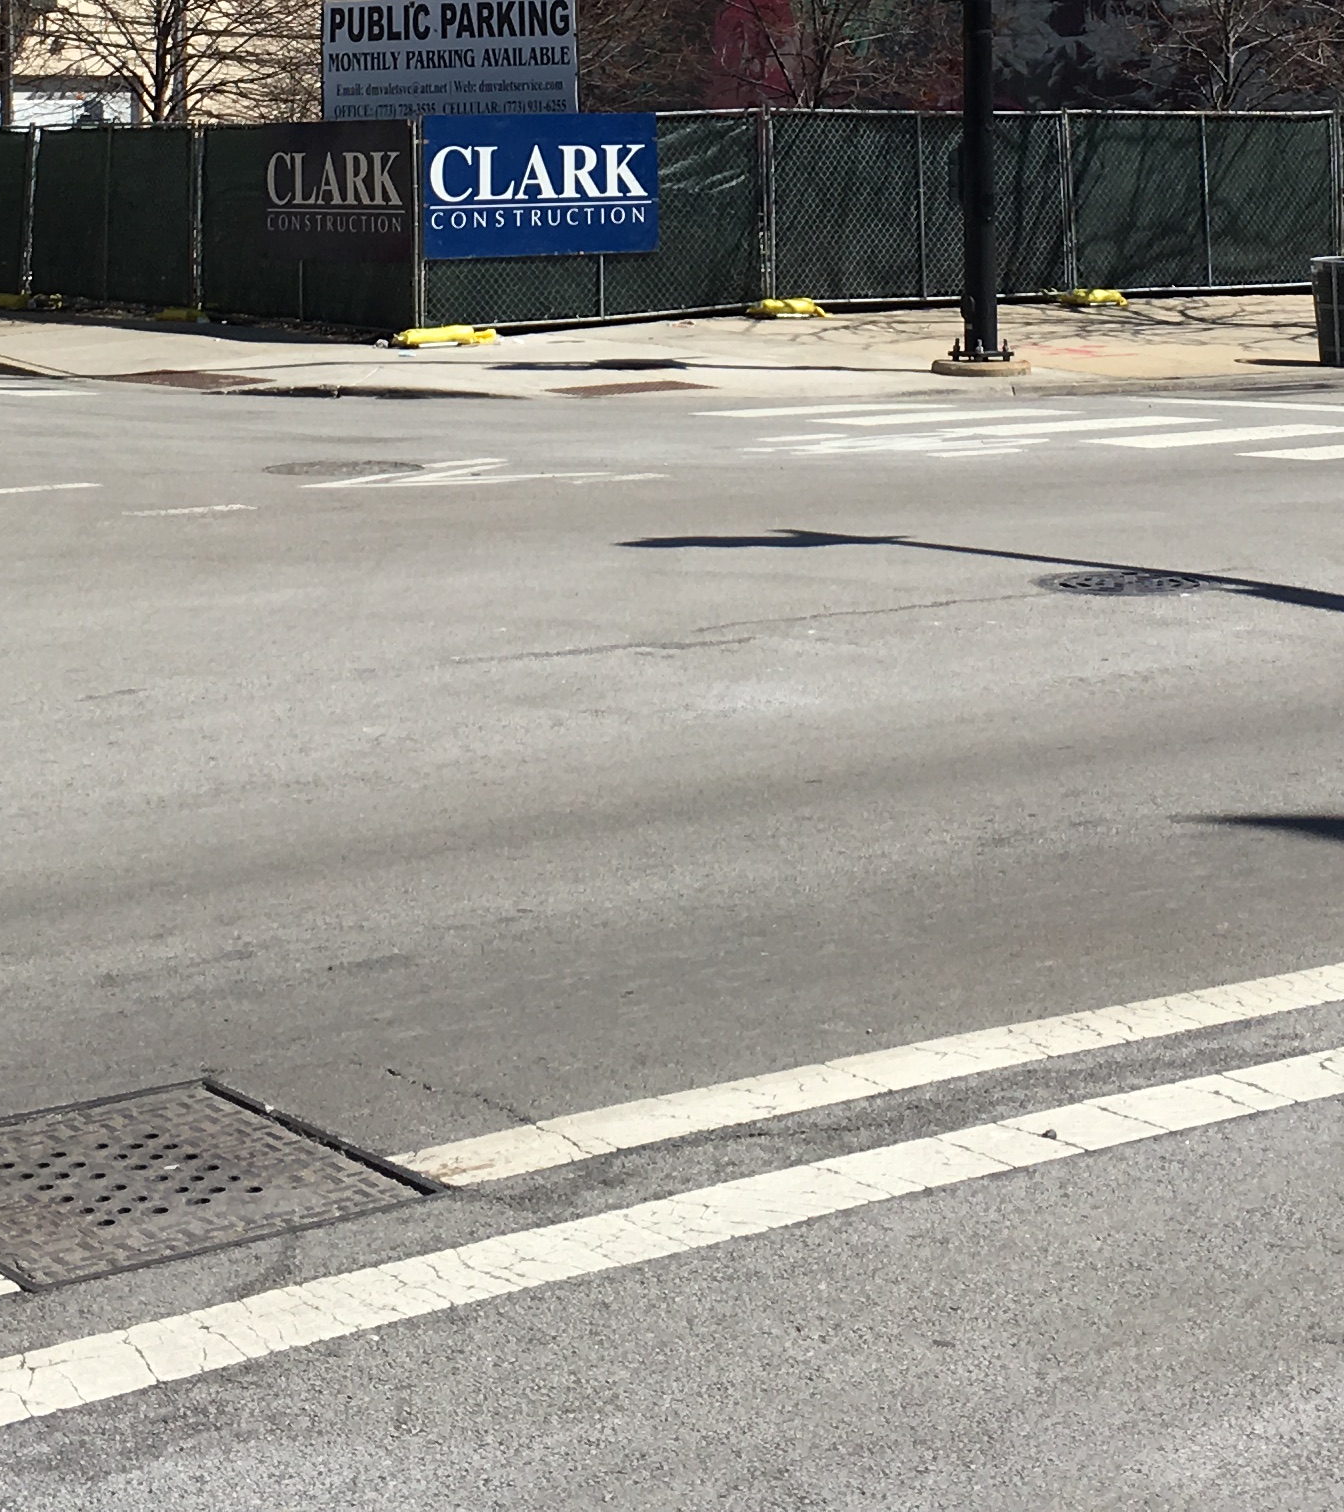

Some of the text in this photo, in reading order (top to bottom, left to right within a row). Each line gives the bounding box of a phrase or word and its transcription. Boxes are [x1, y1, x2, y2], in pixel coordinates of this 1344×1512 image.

[329, 3, 431, 43] PUBLIC
[328, 45, 571, 73] MONTHLY PARKING AVAILABLE
[336, 82, 364, 97] Email:
[453, 80, 476, 94] Web:
[479, 79, 564, 93] dmvaletservice.com
[333, 103, 373, 118] OFFICE:
[503, 100, 526, 113] (773)
[527, 99, 567, 113] 931-6255
[267, 151, 404, 206] CLARK
[430, 144, 649, 202] CLARK
[267, 214, 402, 234] CONSTRUCTION
[430, 206, 646, 231] CONSTRUCTION
